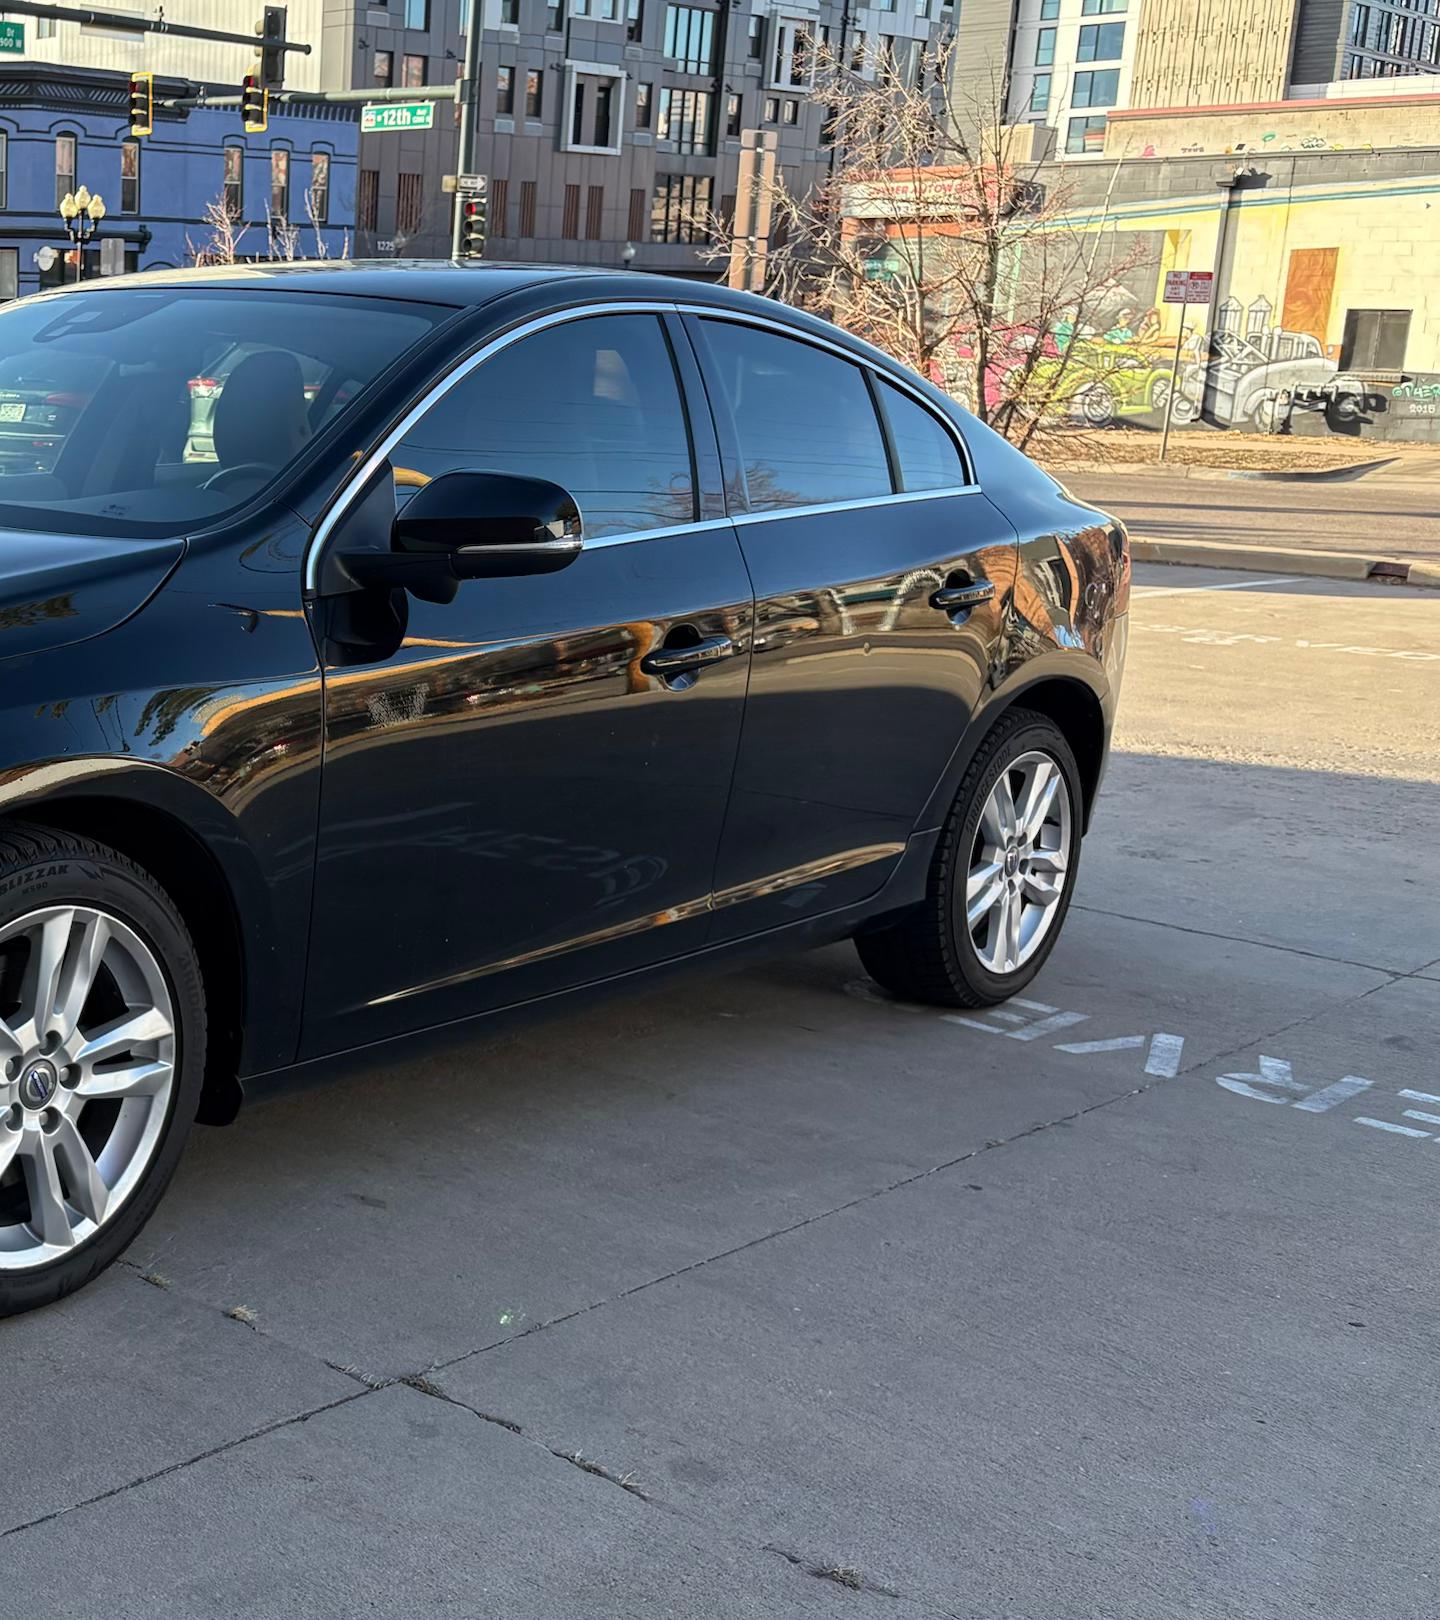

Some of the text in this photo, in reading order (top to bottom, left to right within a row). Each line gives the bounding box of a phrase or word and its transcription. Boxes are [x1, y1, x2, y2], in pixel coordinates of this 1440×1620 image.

[6, 27, 15, 37] Dr
[0, 37, 14, 47] 900
[383, 109, 411, 126] 12th
